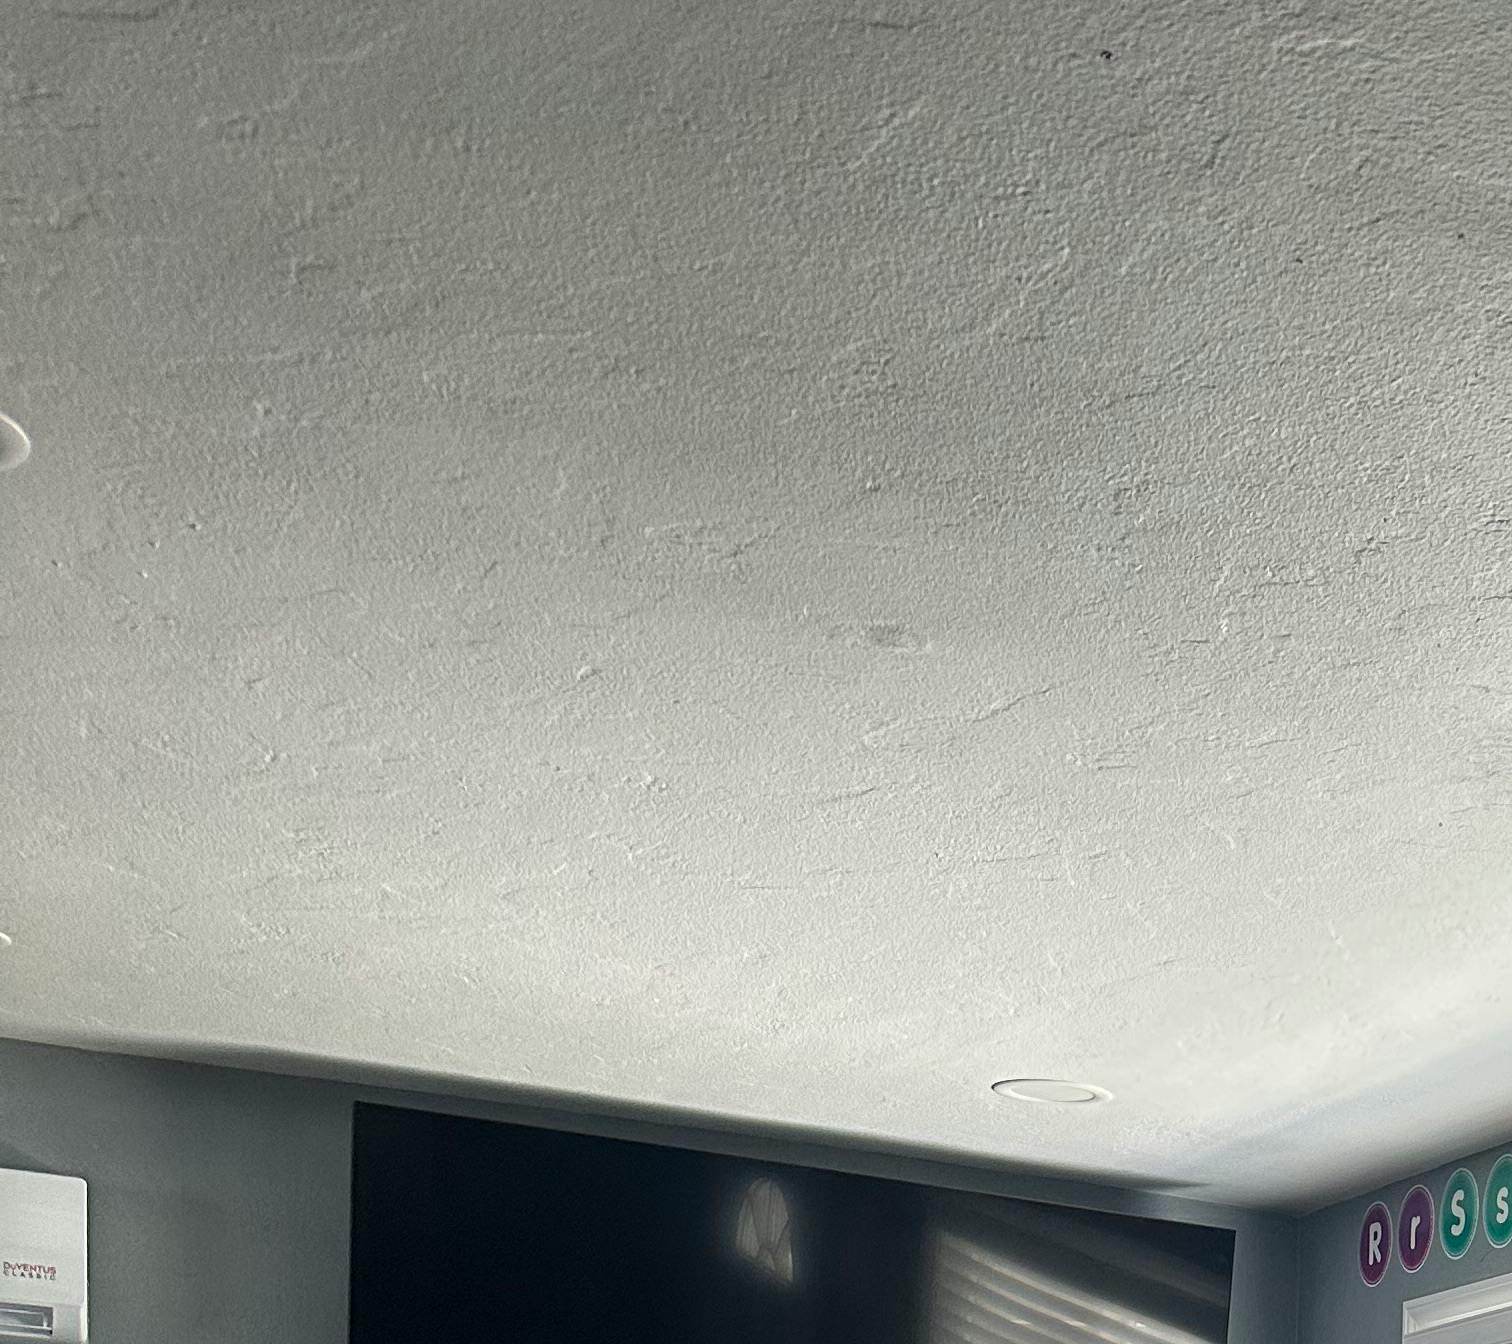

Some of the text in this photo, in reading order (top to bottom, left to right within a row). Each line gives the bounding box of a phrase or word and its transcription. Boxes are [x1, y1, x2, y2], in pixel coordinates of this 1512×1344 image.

[1368, 1222, 1383, 1267] R
[1410, 1215, 1422, 1251] r
[1450, 1190, 1467, 1237] S
